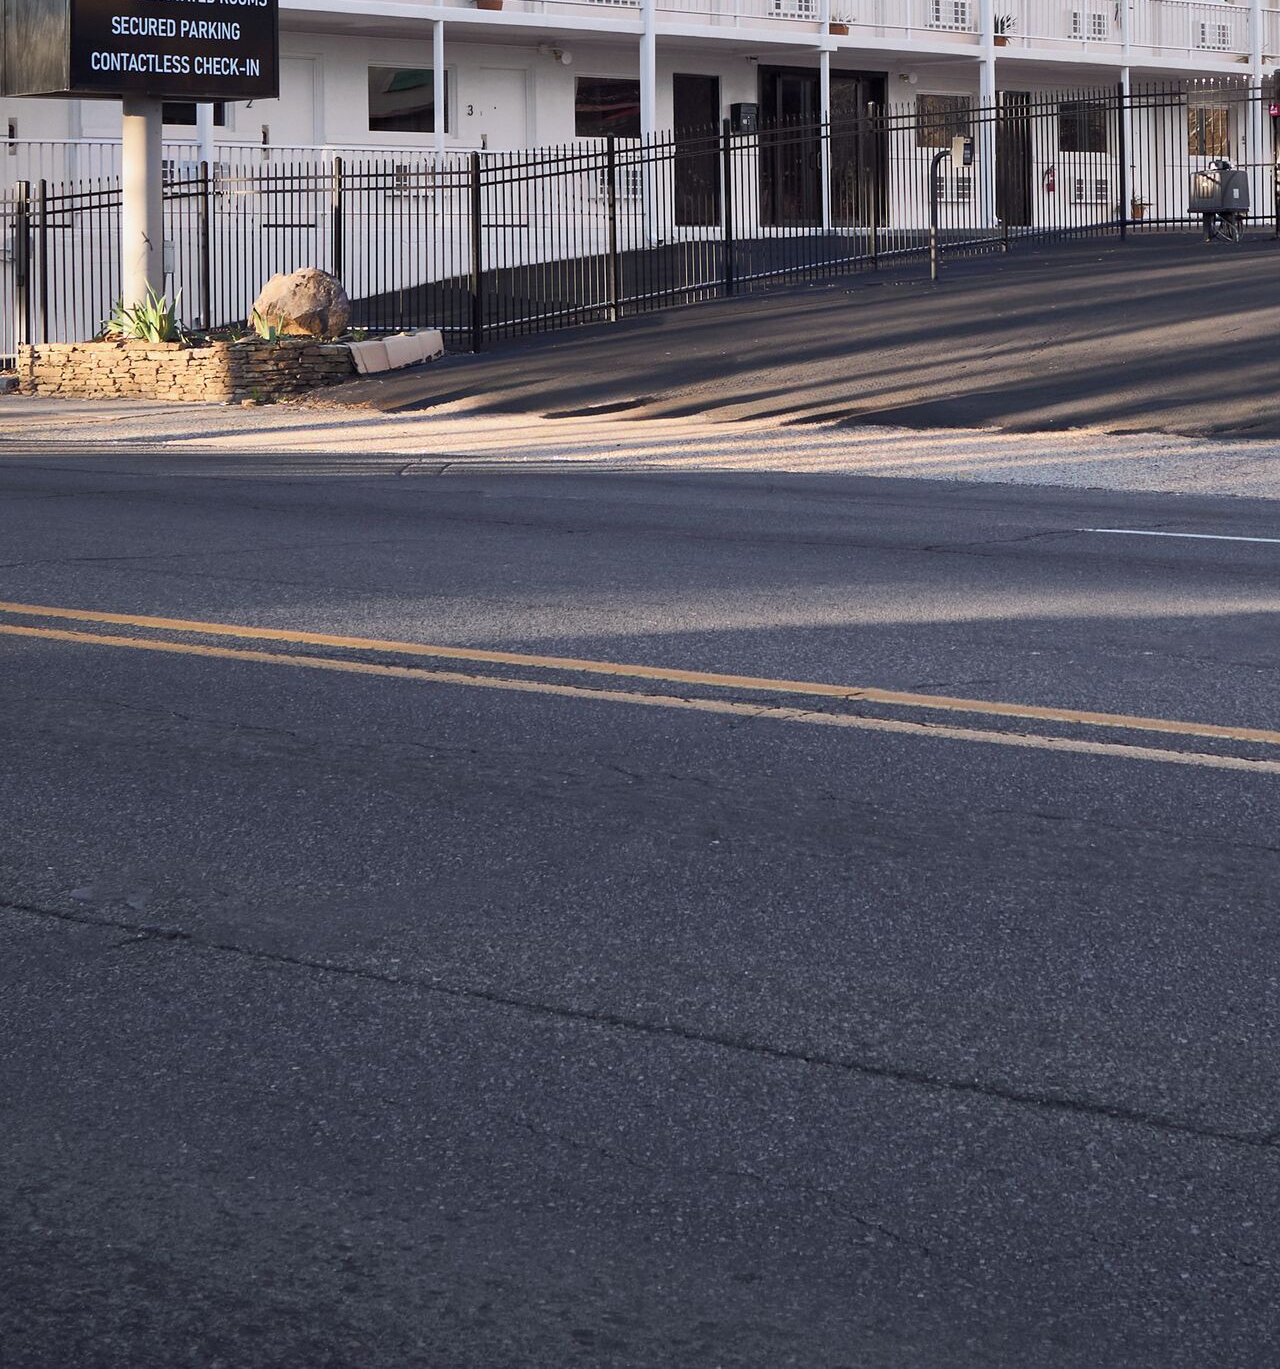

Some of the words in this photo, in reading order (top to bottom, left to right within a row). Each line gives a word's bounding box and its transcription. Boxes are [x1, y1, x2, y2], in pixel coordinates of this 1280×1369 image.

[111, 16, 176, 37] SECURED
[180, 19, 241, 41] PARKING
[91, 51, 190, 74] CONTACTLESS
[194, 56, 260, 77] CHECK-IN
[467, 104, 474, 116] 3
